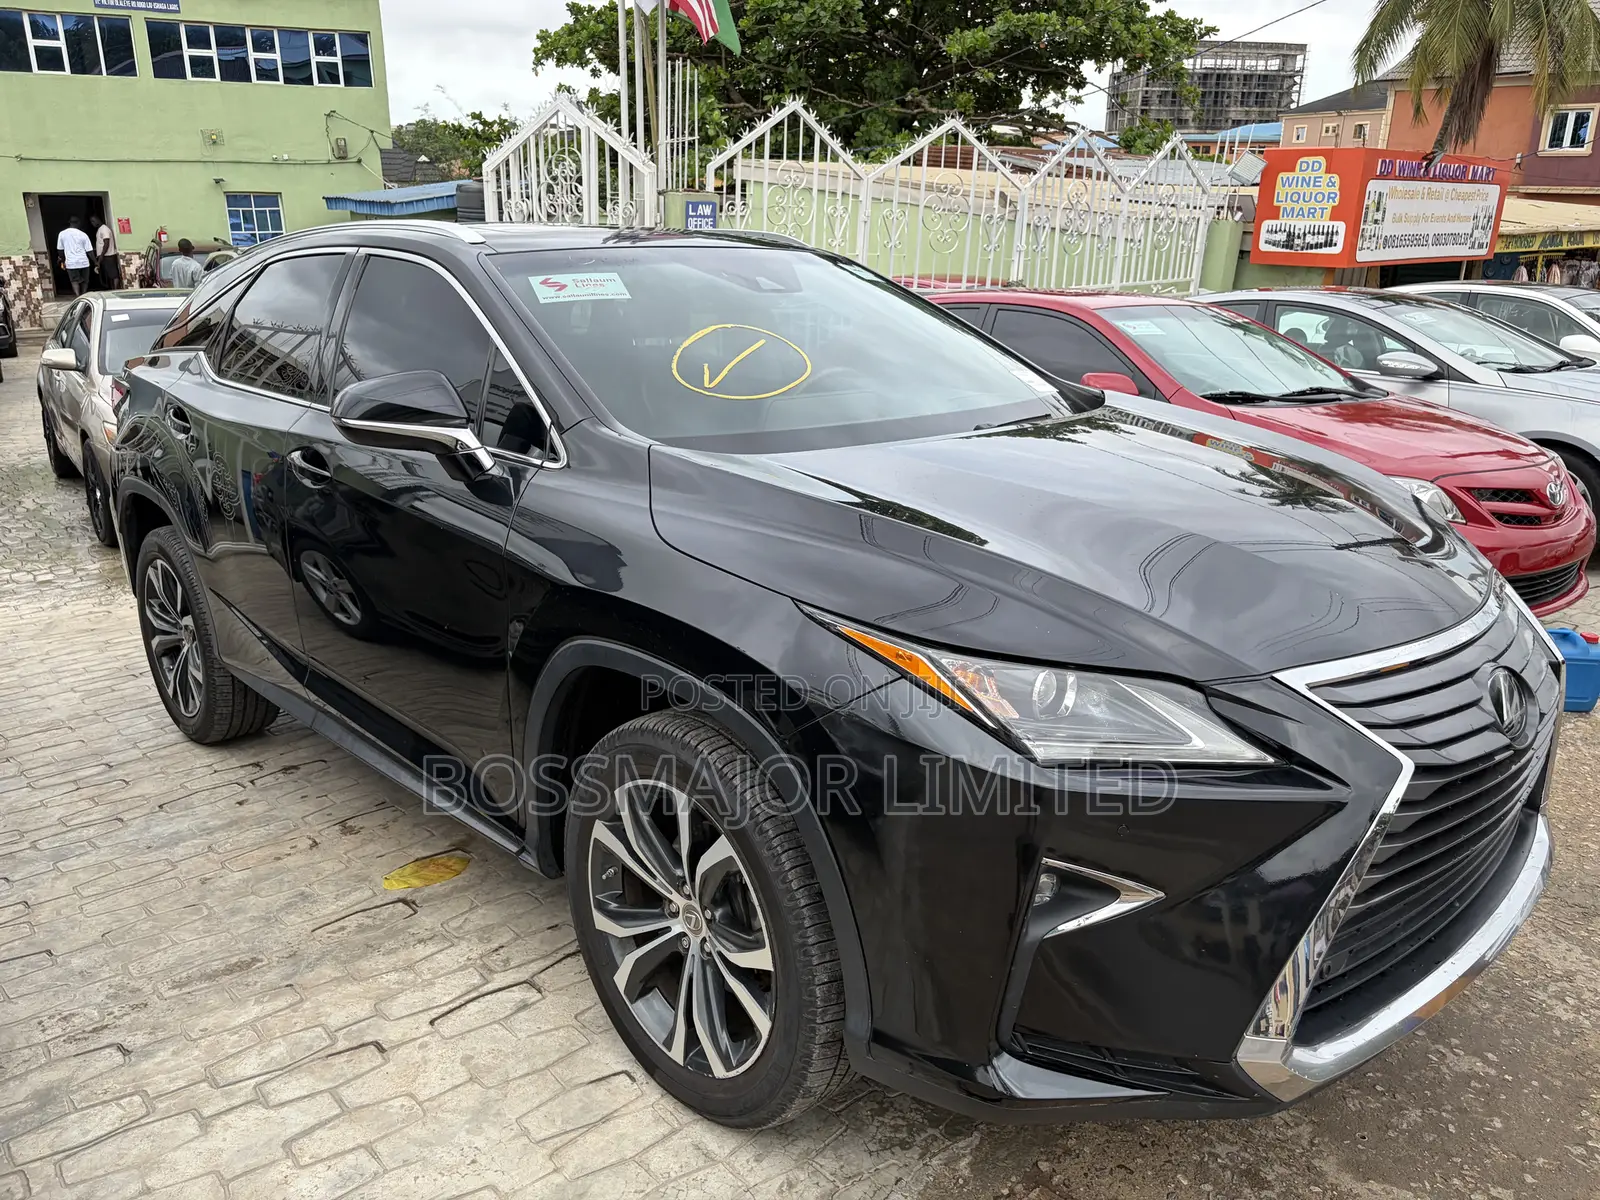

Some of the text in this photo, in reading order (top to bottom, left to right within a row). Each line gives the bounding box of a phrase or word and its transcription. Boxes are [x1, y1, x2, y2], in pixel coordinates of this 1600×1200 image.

[1298, 160, 1323, 173] DD
[1376, 158, 1394, 176] DD
[1430, 162, 1468, 180] LIQUOR
[1468, 164, 1497, 182] MART
[1280, 175, 1337, 189] WINE &
[1275, 191, 1339, 205] LIQUOR
[1388, 184, 1420, 200] Wholesale
[1426, 186, 1444, 201] Retail
[1450, 187, 1476, 204] Cheapest
[1476, 188, 1489, 203] Price
[688, 204, 713, 216] LAW
[1281, 206, 1329, 219] MART
[687, 217, 714, 230] OFFICE
[1403, 212, 1421, 227] Supply
[1421, 212, 1431, 224] For
[1430, 212, 1447, 224] Events
[1447, 212, 1457, 224] And
